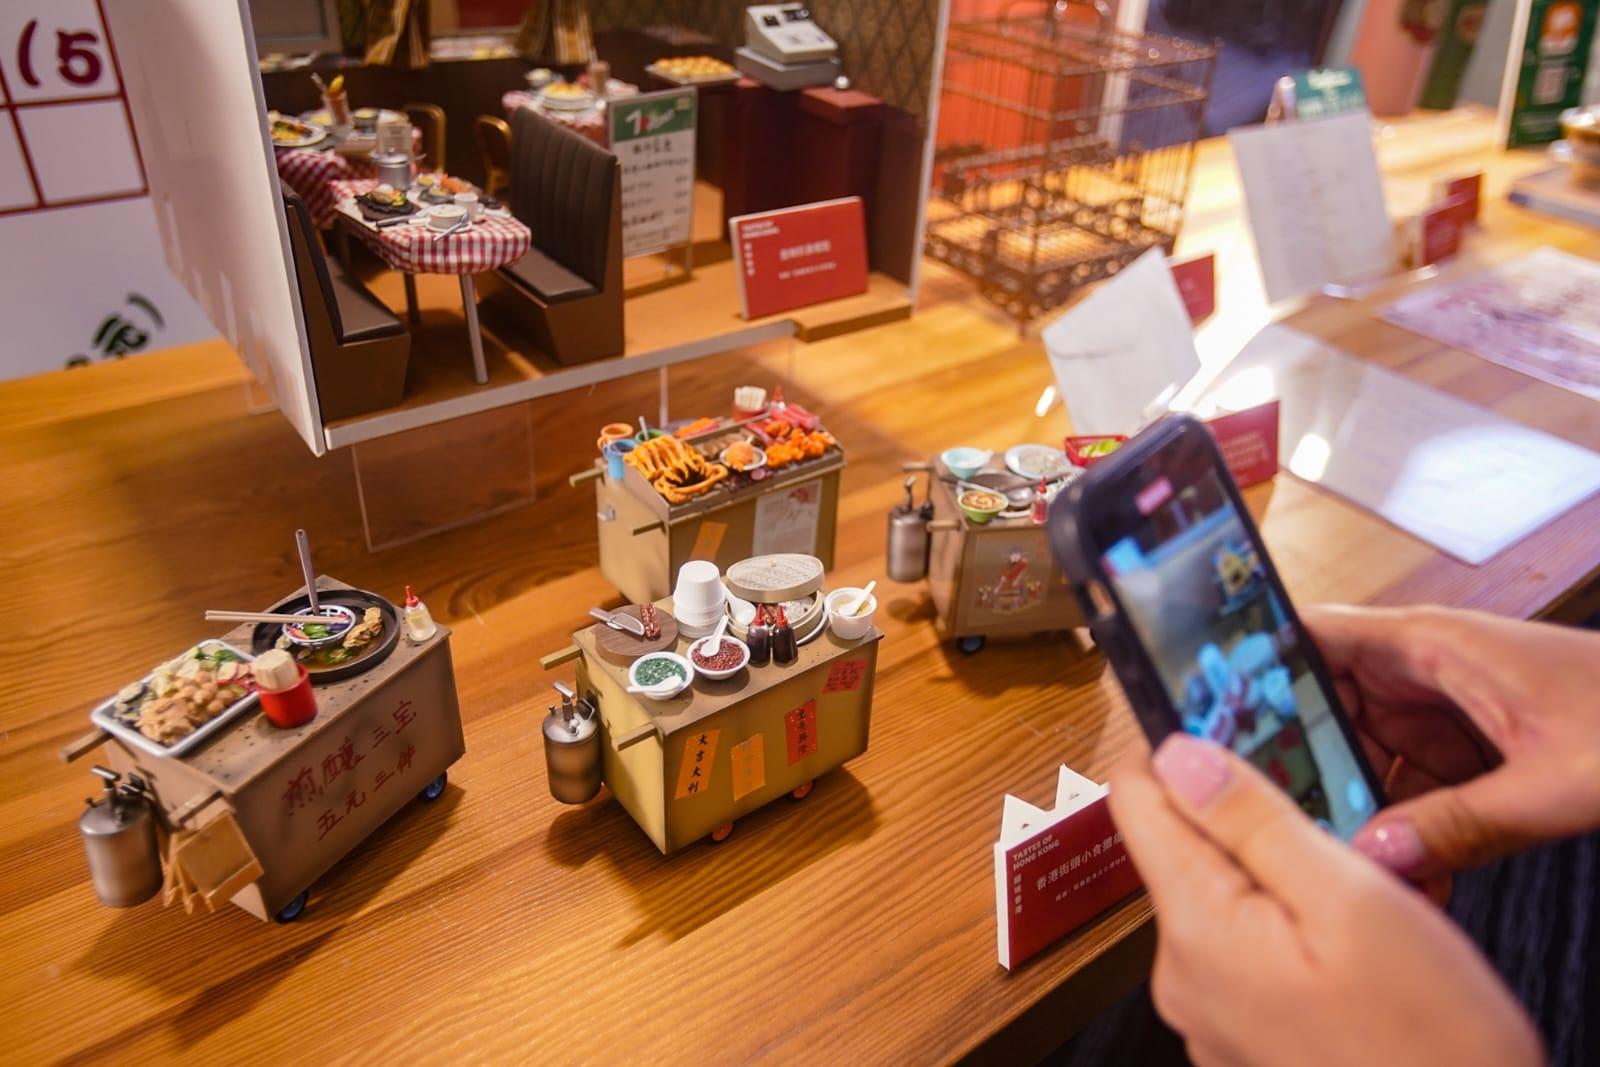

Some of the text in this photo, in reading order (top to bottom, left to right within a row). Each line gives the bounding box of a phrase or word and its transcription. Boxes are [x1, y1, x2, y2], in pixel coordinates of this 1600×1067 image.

[65, 291, 166, 370] 元)
[688, 734, 708, 794] 大吉大利
[1013, 841, 1041, 862] TASTES
[1013, 839, 1060, 871] HONG KONG
